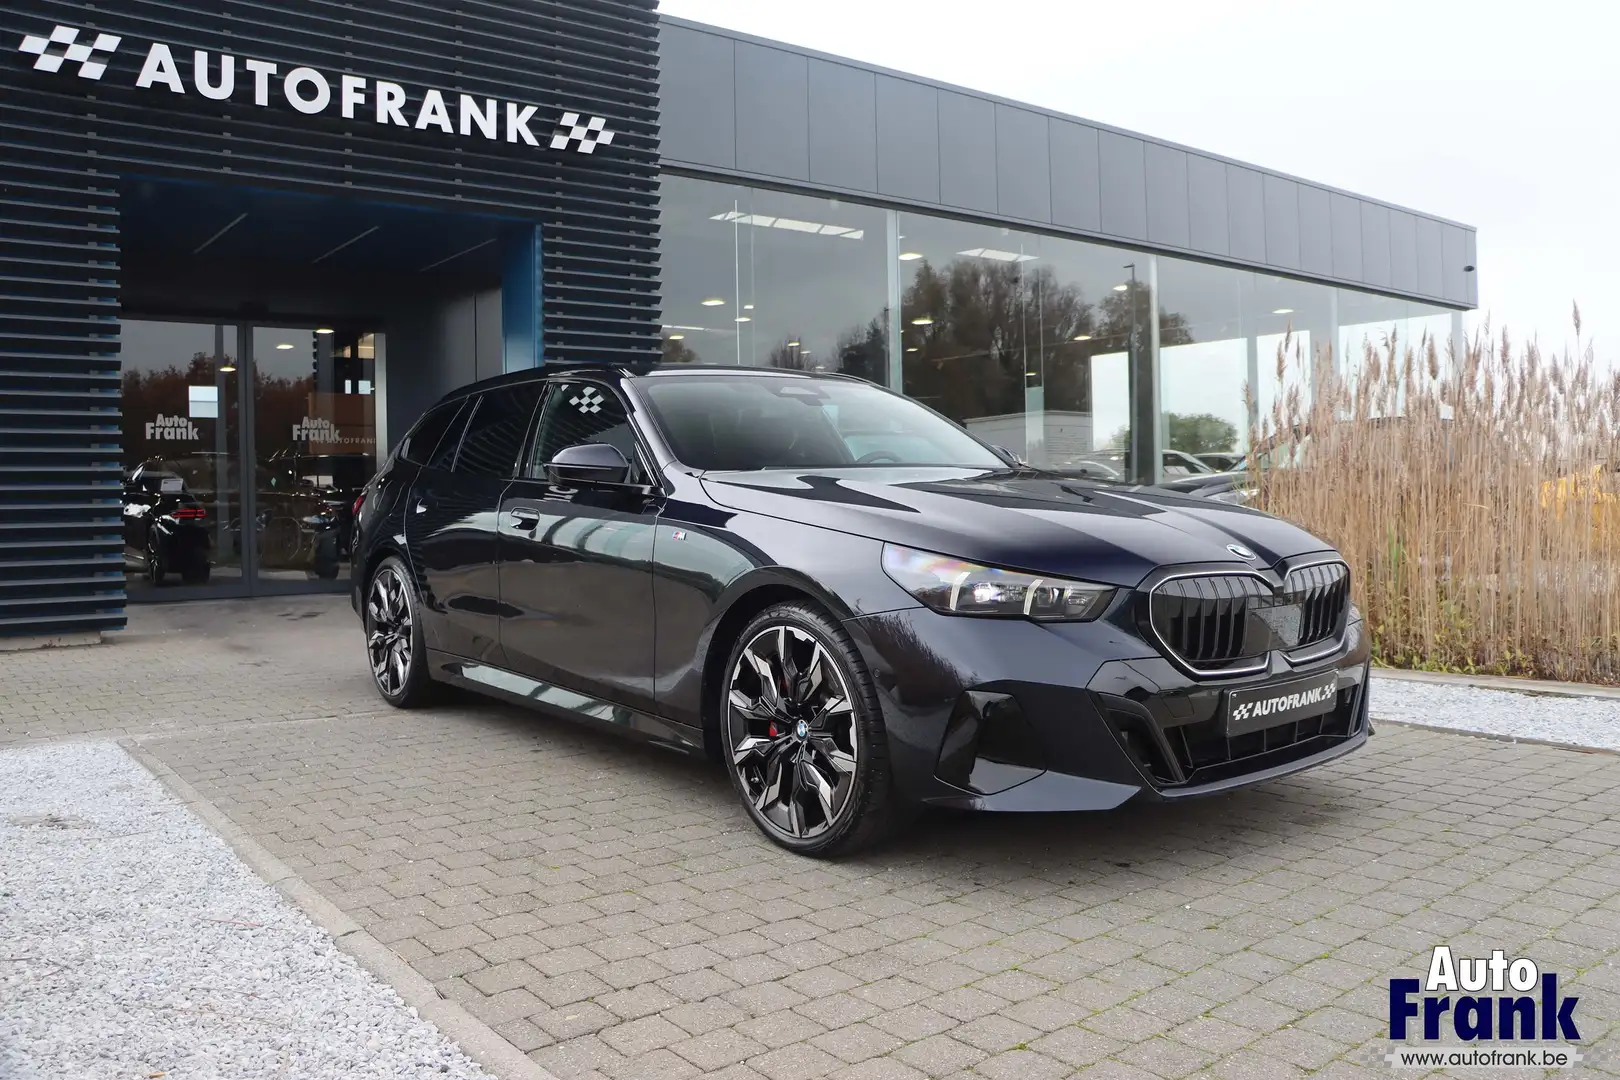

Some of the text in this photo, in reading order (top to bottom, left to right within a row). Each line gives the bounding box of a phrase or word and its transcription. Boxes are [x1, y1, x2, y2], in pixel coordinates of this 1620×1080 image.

[136, 43, 540, 147] AUTOFRANK
[155, 413, 188, 427] Auto
[302, 416, 330, 429] Auto
[145, 421, 200, 440] Frank
[292, 423, 340, 441] Frank
[1252, 687, 1321, 718] AUTOFRANK
